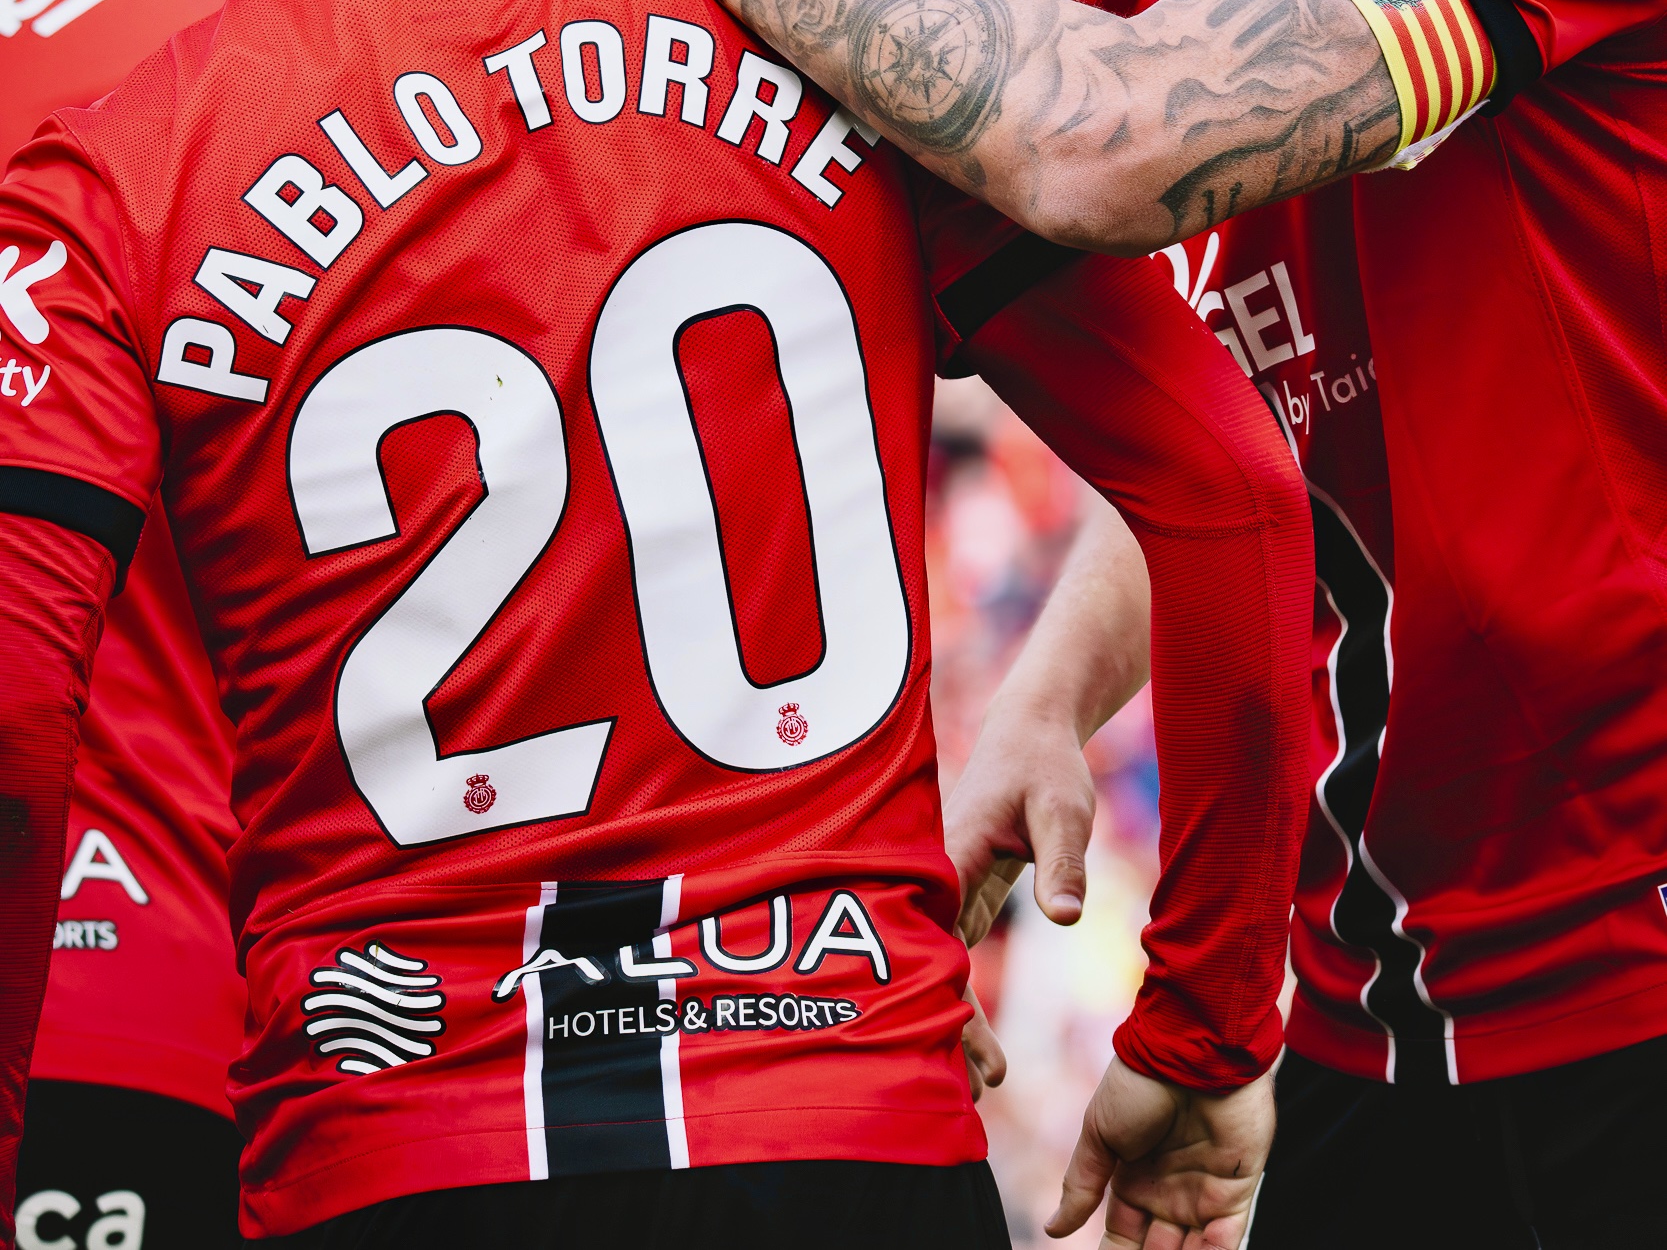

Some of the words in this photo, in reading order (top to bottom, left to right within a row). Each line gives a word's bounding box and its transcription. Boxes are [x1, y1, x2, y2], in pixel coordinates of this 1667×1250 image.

[155, 70, 484, 405] PABLO
[482, 12, 884, 211] TORRE
[1283, 380, 1309, 435] by
[286, 218, 914, 850] 20
[492, 888, 892, 1003] ALUA
[549, 1003, 676, 1039] HOTELS
[683, 1001, 708, 1030] &
[716, 996, 859, 1028] RESORTS
